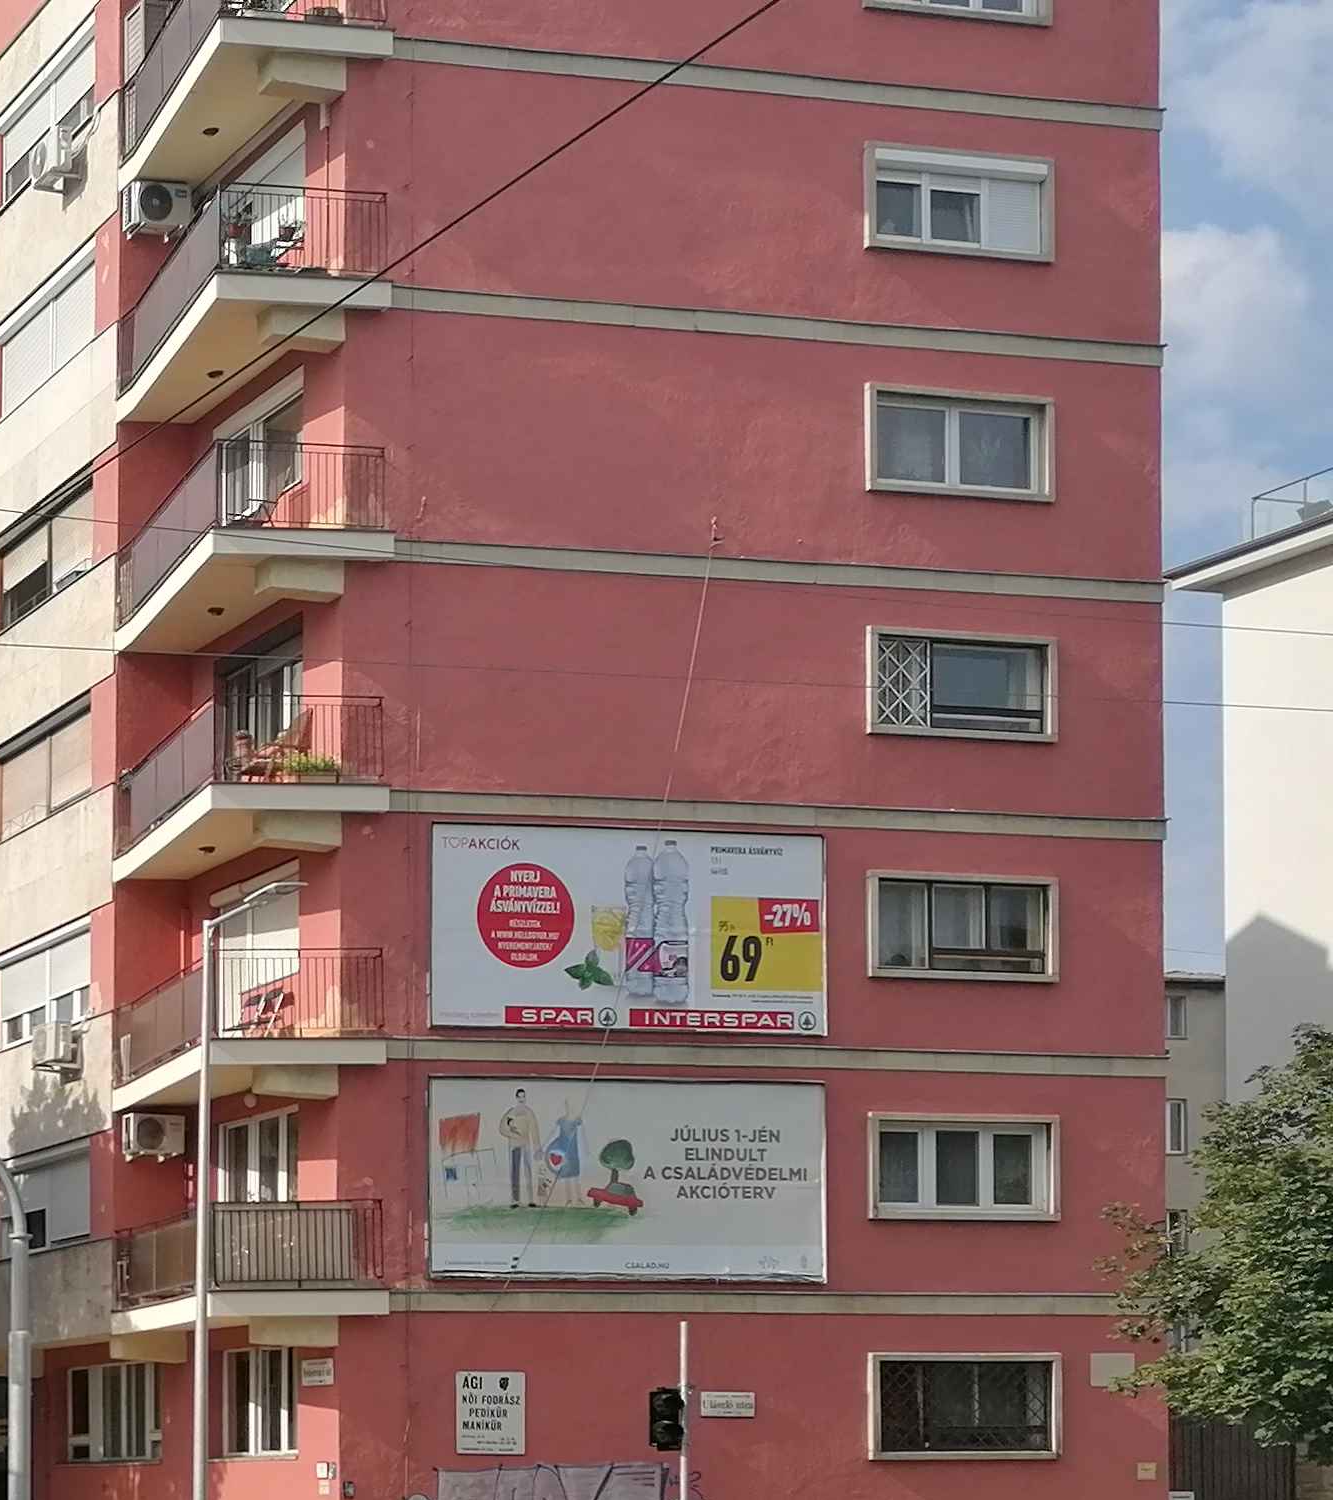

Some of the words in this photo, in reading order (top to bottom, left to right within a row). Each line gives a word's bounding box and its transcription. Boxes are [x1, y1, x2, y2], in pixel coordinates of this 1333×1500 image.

[510, 870, 541, 883] NYERJ
[493, 885, 501, 898] A
[503, 886, 557, 899] PRIMAVERA
[764, 904, 811, 928] -27%
[720, 935, 763, 982] 69
[522, 1008, 593, 1024] SPAR
[644, 1012, 793, 1028] INTERSPAR
[670, 1125, 730, 1142] JÚLIUS
[734, 1126, 780, 1143] 1-JÉN
[684, 1147, 767, 1162] ELINDULT
[643, 1166, 656, 1180] A
[661, 1164, 807, 1182] CSALÁDVÉDELMI
[676, 1183, 775, 1199] AKCIÓTERV
[462, 1373, 483, 1390] ÁGI
[481, 1393, 521, 1405] FODRÁSZ
